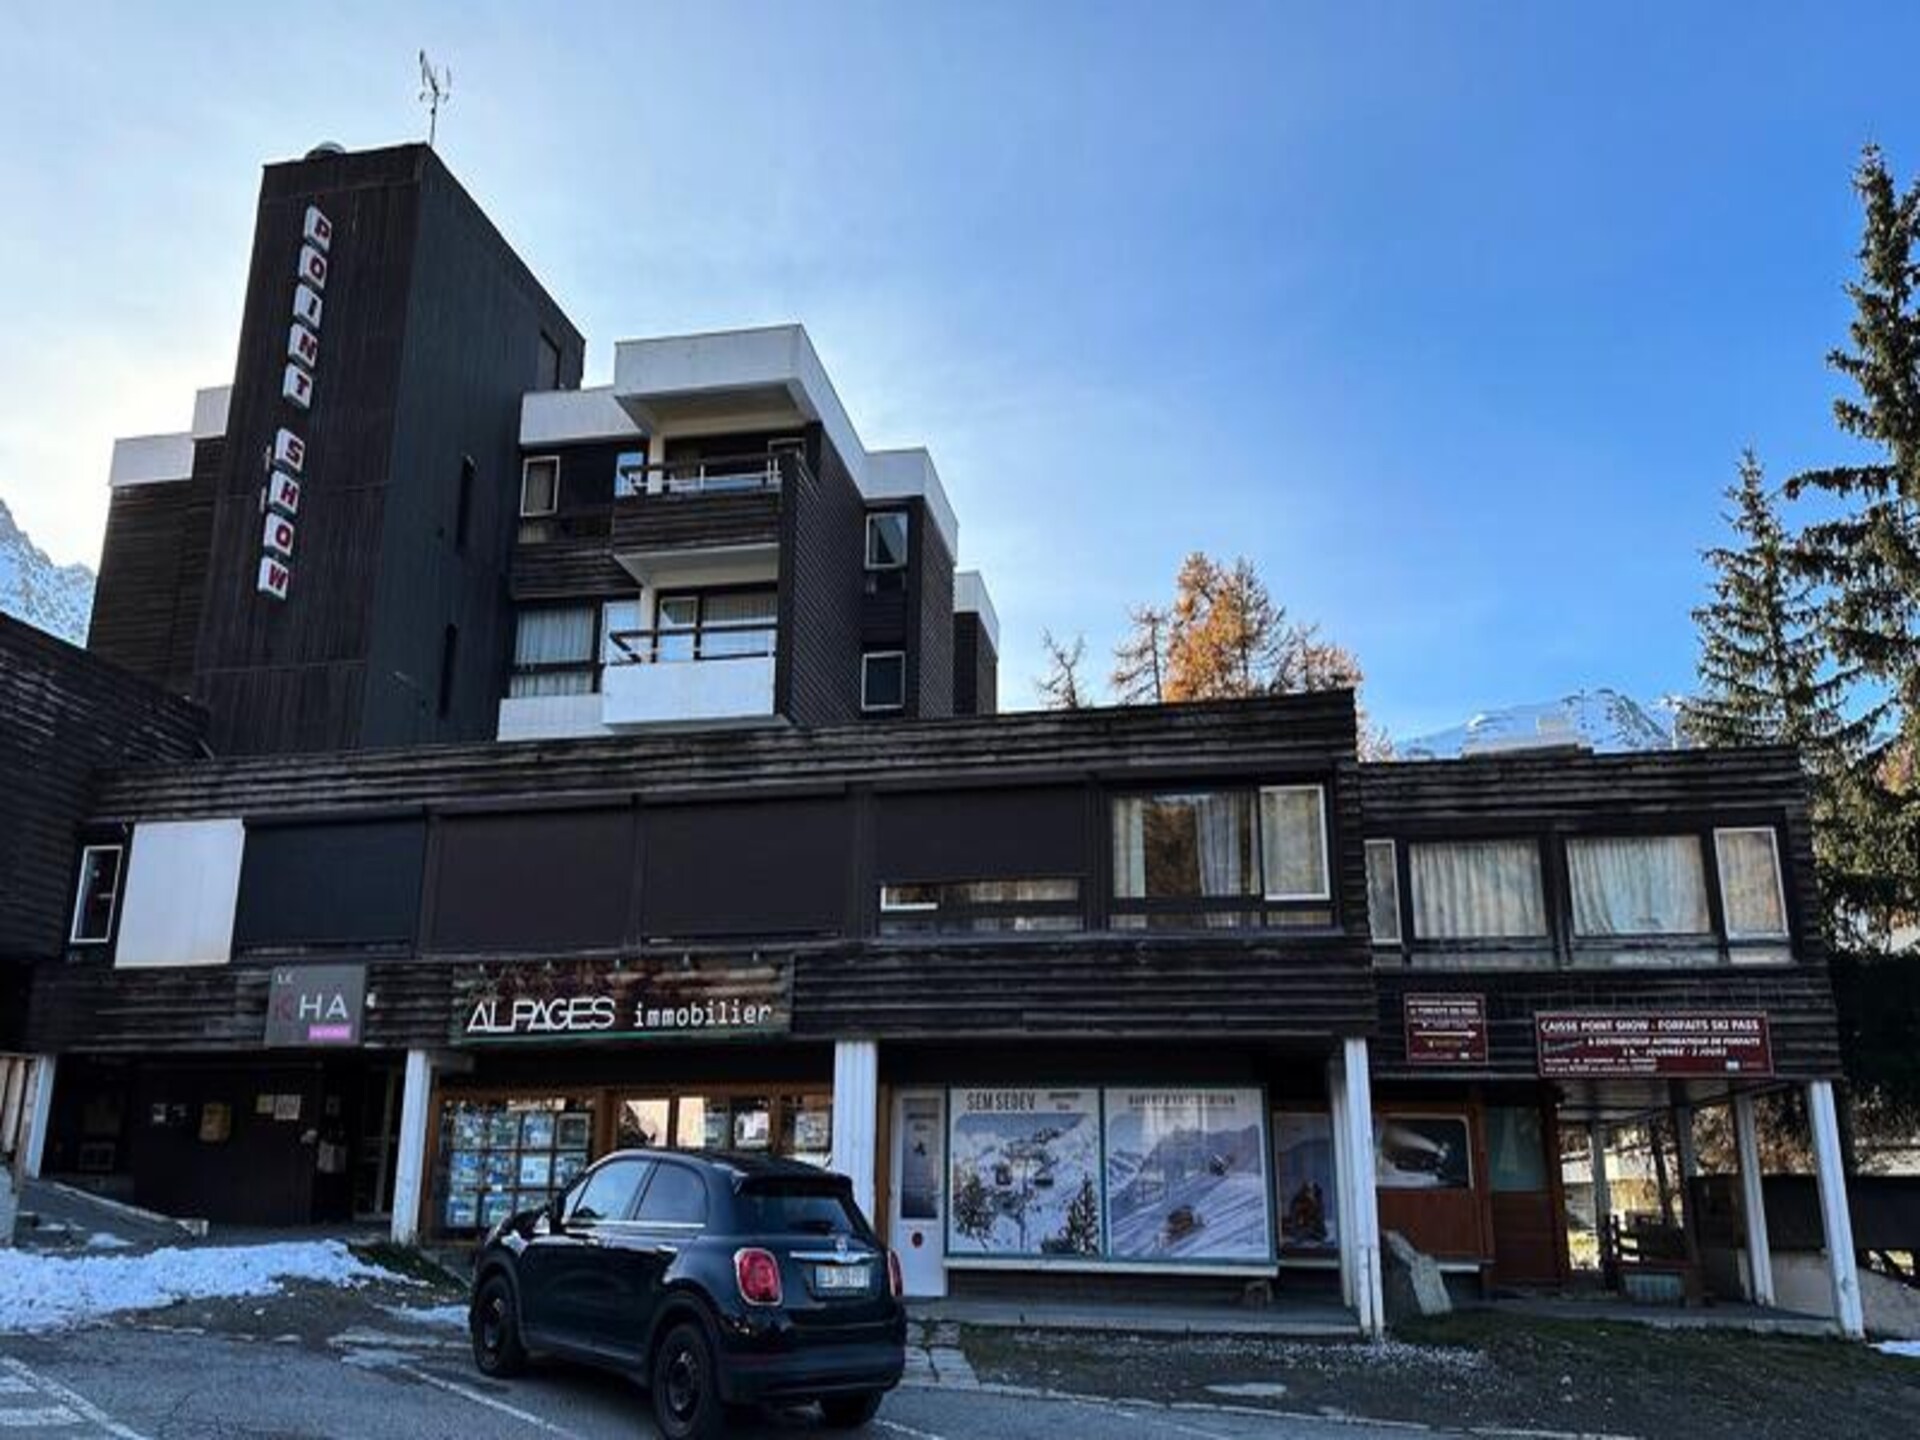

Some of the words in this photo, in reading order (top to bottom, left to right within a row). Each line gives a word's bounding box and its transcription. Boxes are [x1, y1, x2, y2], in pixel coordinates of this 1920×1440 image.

[292, 213, 332, 399] POINT
[266, 435, 303, 592] SHOW
[467, 997, 616, 1032] ALPAGES
[633, 998, 772, 1028] immobilier
[1540, 1019, 1578, 1033] CAISSE
[1581, 1019, 1613, 1032] POINT
[1615, 1019, 1649, 1032] SHOW
[1658, 1019, 1709, 1031] FORFAITS
[1711, 1019, 1729, 1031] SKI
[1732, 1019, 1760, 1031] PASS
